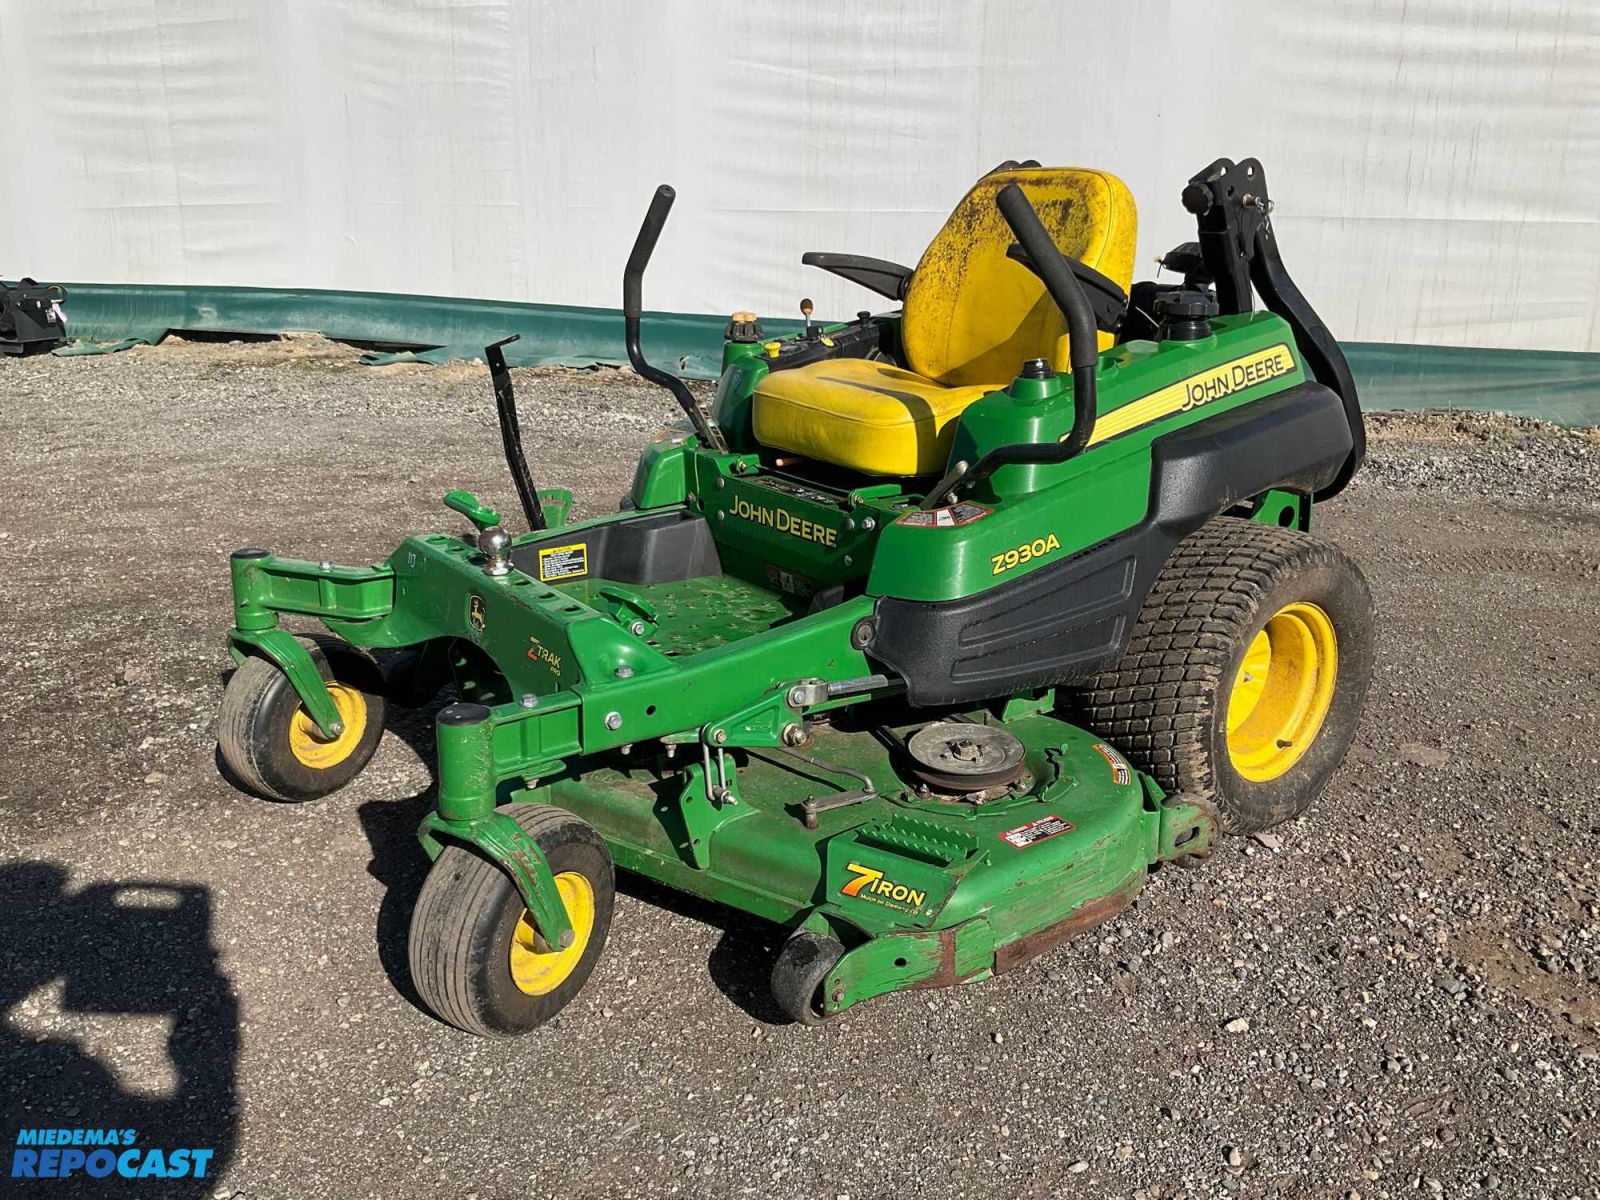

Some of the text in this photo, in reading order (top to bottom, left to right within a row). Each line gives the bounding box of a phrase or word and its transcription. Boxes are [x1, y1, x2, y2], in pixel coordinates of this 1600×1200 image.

[1181, 355, 1285, 409] JOHN DEERE
[729, 494, 838, 549] JOHN DEERE
[991, 533, 1061, 575] Z930A
